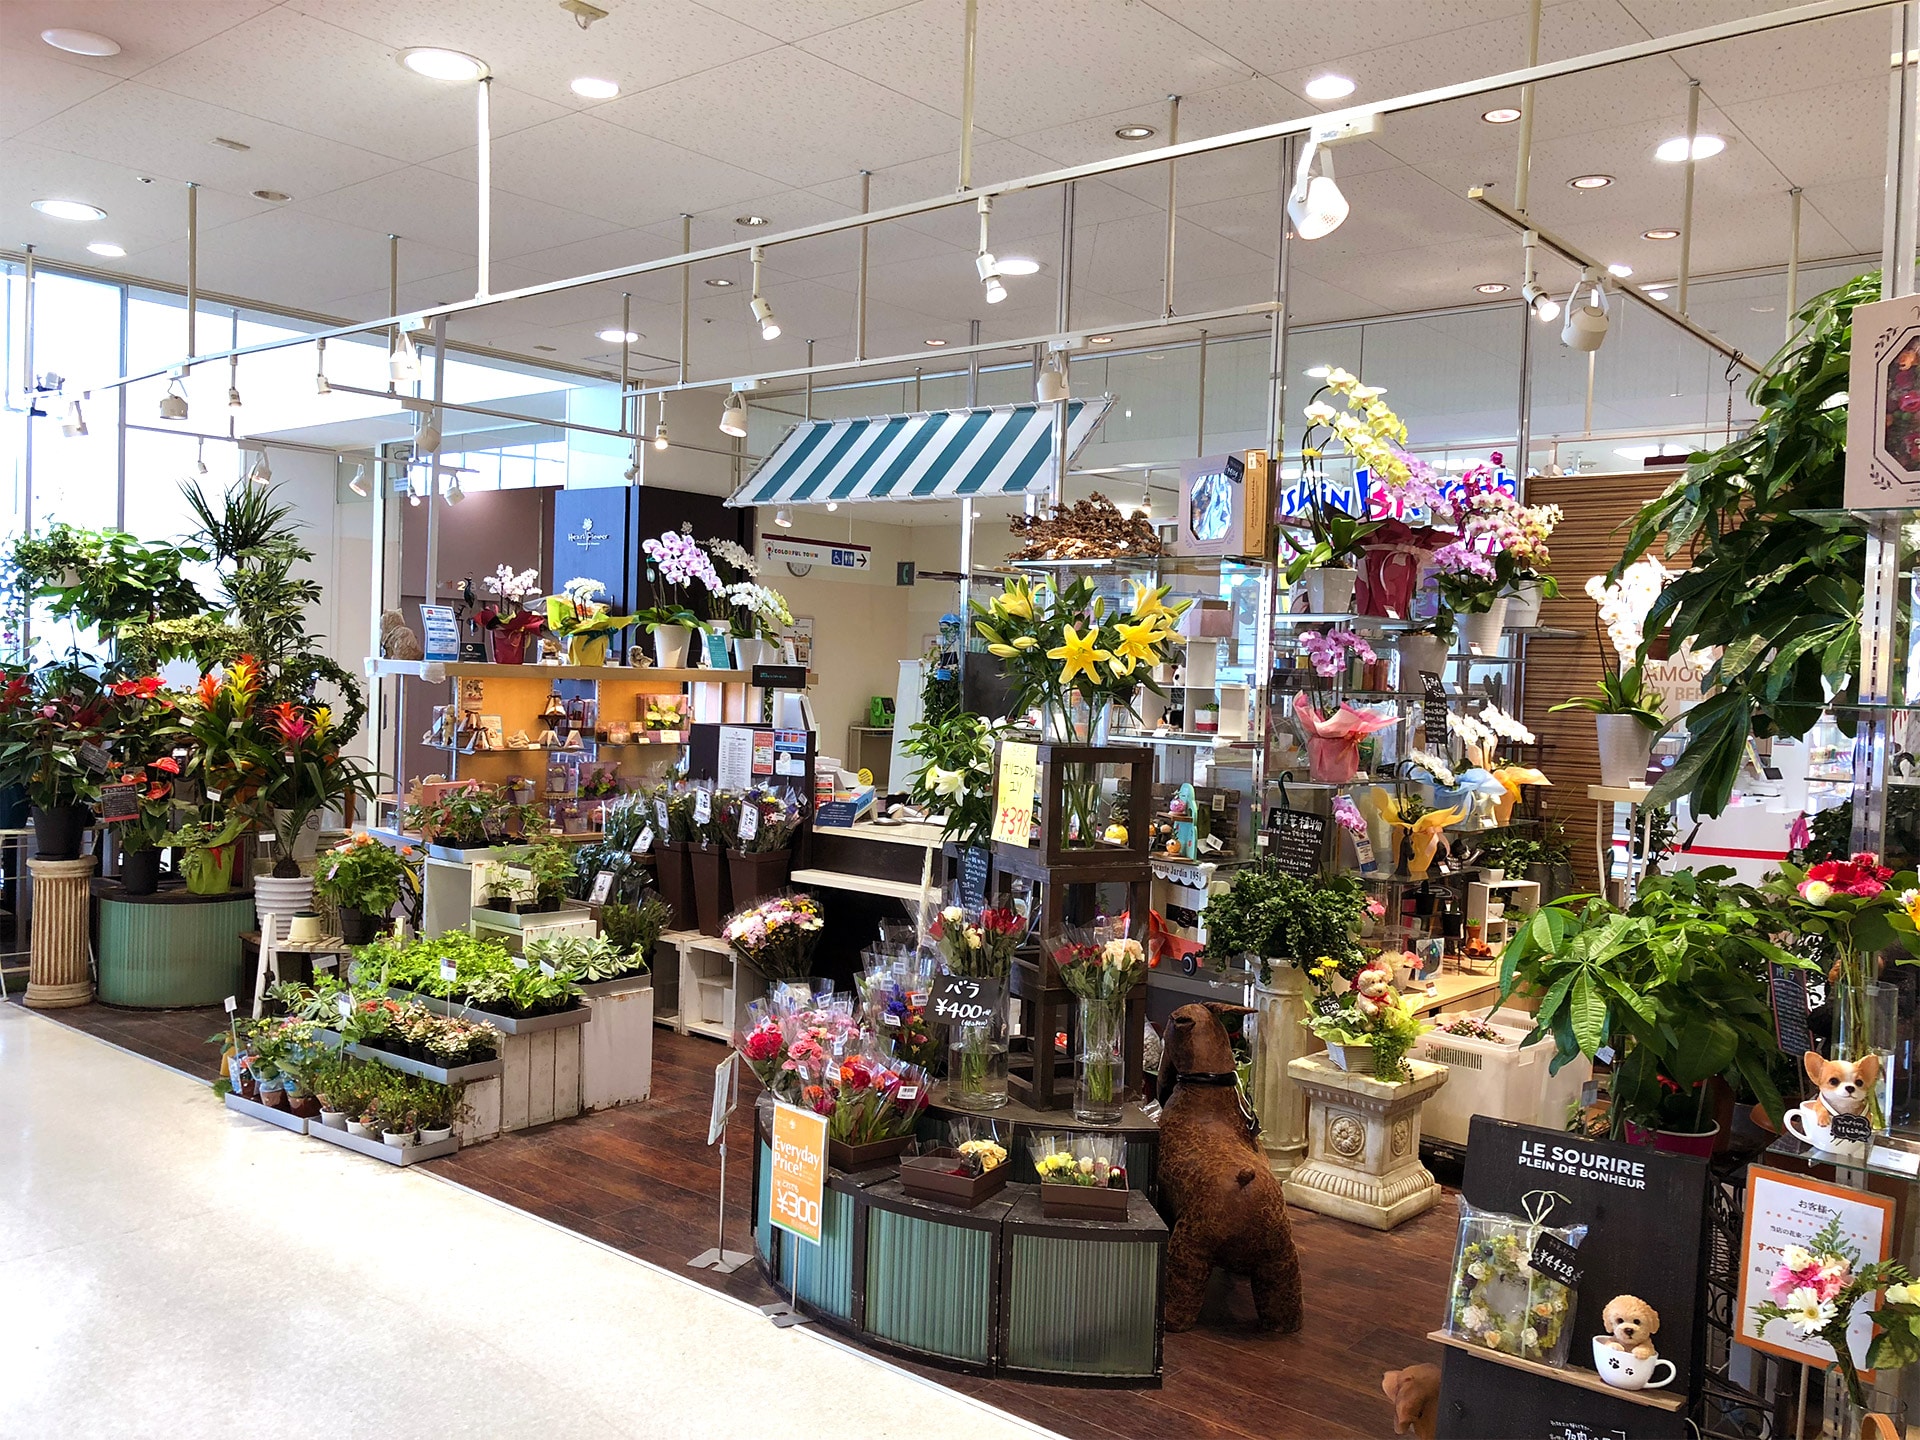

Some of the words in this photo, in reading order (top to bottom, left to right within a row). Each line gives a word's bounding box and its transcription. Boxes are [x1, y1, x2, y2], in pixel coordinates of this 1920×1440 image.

[774, 548, 801, 557] COLORFUL
[1000, 806, 1030, 838] ¥398
[1170, 865, 1187, 878] Jardin
[945, 980, 980, 999] バラ
[935, 998, 982, 1019] ¥400
[774, 1135, 820, 1171] Everyday
[774, 1151, 803, 1177] Price!
[1521, 1140, 1546, 1158] LE
[1551, 1146, 1646, 1178] SOURIRE
[1518, 1156, 1556, 1171] PLEIN
[1558, 1164, 1577, 1176] DE
[1579, 1168, 1646, 1190] BONHEUR
[776, 1188, 819, 1227] ¥300
[1797, 1200, 1838, 1217] お客様へ
[1757, 1242, 1785, 1257] すべて
